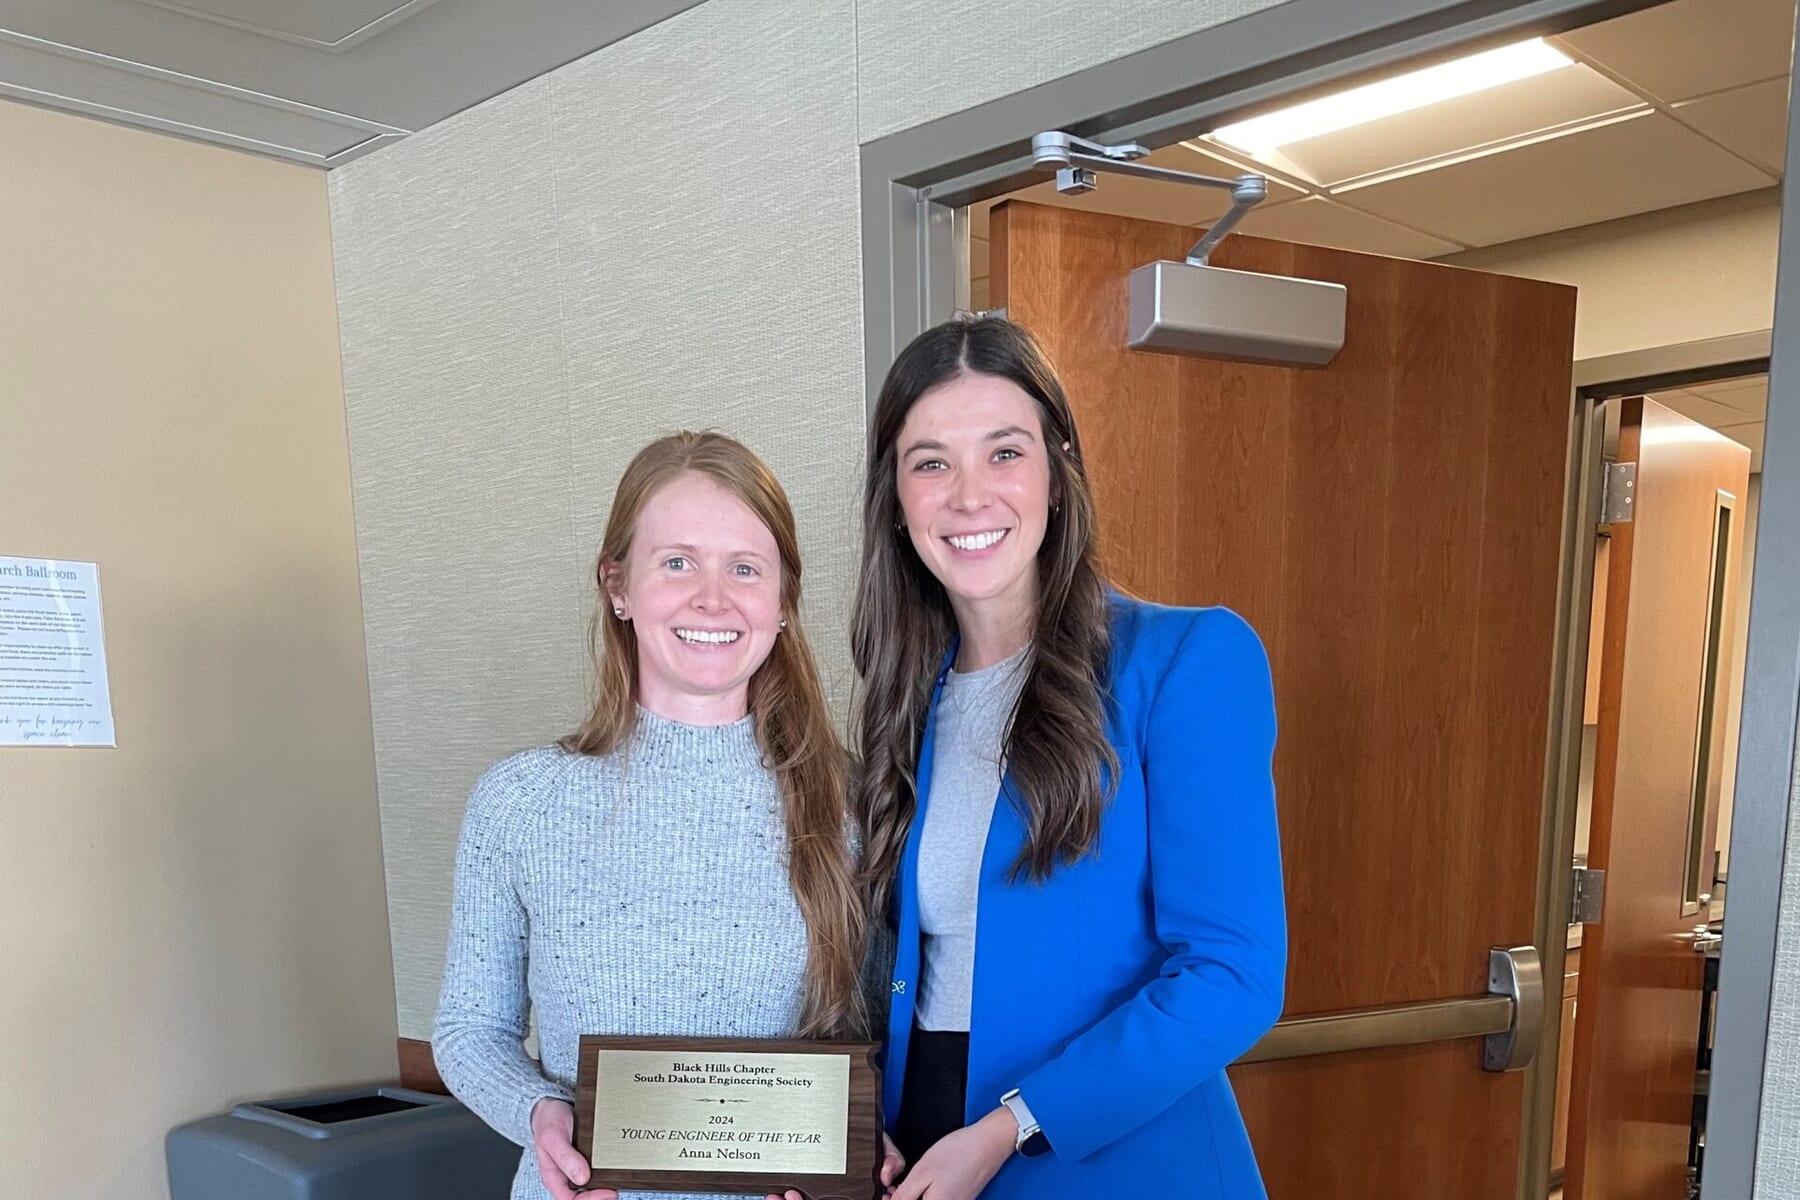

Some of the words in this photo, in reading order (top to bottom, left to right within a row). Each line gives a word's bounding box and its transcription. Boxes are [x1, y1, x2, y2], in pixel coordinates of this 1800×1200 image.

[25, 566, 77, 580] Ballroom
[673, 1062, 702, 1073] Black
[705, 1063, 731, 1074] Hills
[733, 1064, 776, 1076] Chapter
[634, 1073, 665, 1083] South
[667, 1074, 706, 1085] Dakota
[709, 1075, 774, 1087] Engineering
[775, 1076, 814, 1088] Society
[708, 1115, 735, 1125] 2024
[620, 1128, 666, 1141] YOUNG
[668, 1130, 736, 1142] ENGINEER
[738, 1131, 756, 1142] OF
[757, 1132, 784, 1143] THE
[787, 1132, 821, 1144] YEAR
[678, 1148, 712, 1159] Anna
[716, 1148, 762, 1160] Nelson
